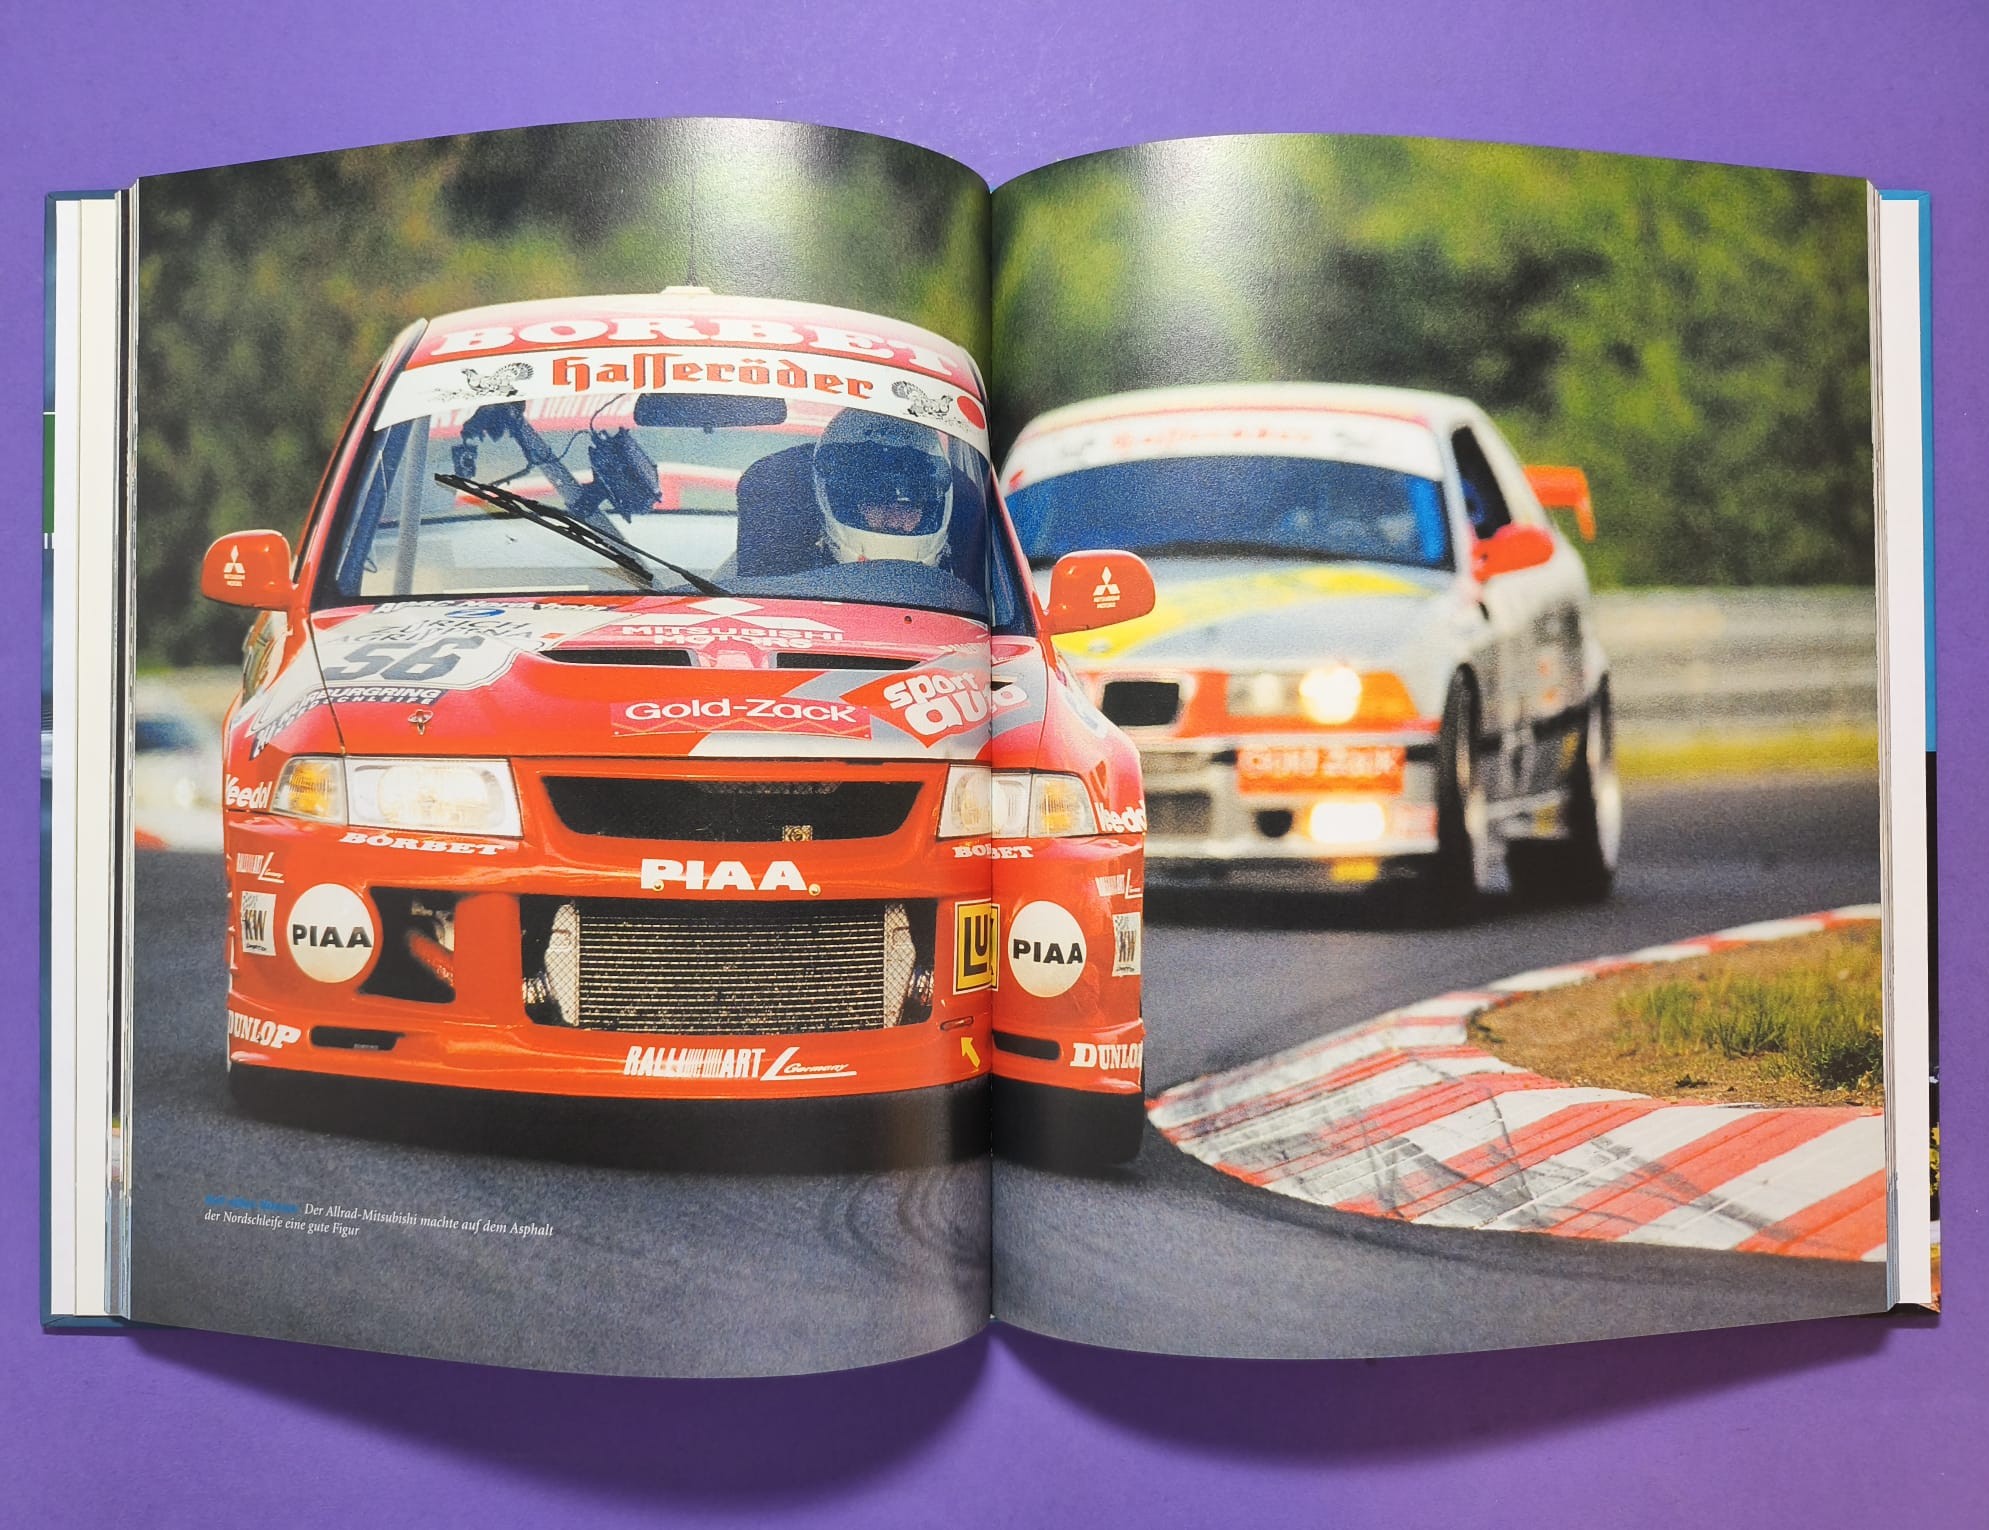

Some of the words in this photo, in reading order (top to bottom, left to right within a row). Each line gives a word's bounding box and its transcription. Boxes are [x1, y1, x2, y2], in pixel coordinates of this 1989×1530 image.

[431, 318, 966, 376] BORBET
[553, 353, 873, 399] Hasseröder
[622, 626, 844, 641] MITSUBISHI
[323, 635, 485, 681] 56
[883, 672, 980, 710] sport
[625, 698, 857, 724] Gold-Zack
[338, 831, 506, 855] BORBET
[640, 858, 808, 891] PIAA
[292, 924, 373, 948] PIAA
[1012, 938, 1084, 965] PIAA
[228, 1009, 302, 1049] DUNLOP
[783, 1063, 850, 1074] Germany
[204, 1209, 220, 1221] der
[221, 1210, 283, 1231] Nordschleife
[285, 1217, 306, 1230] eine
[307, 1221, 330, 1234] gute
[332, 1222, 360, 1238] Figur
[304, 1203, 324, 1216] Der
[325, 1204, 418, 1225] Allrad-Mitsubishi
[420, 1216, 459, 1229] machte
[461, 1218, 482, 1235] auf
[482, 1220, 507, 1233] dem
[509, 1222, 554, 1238] Asphalt
